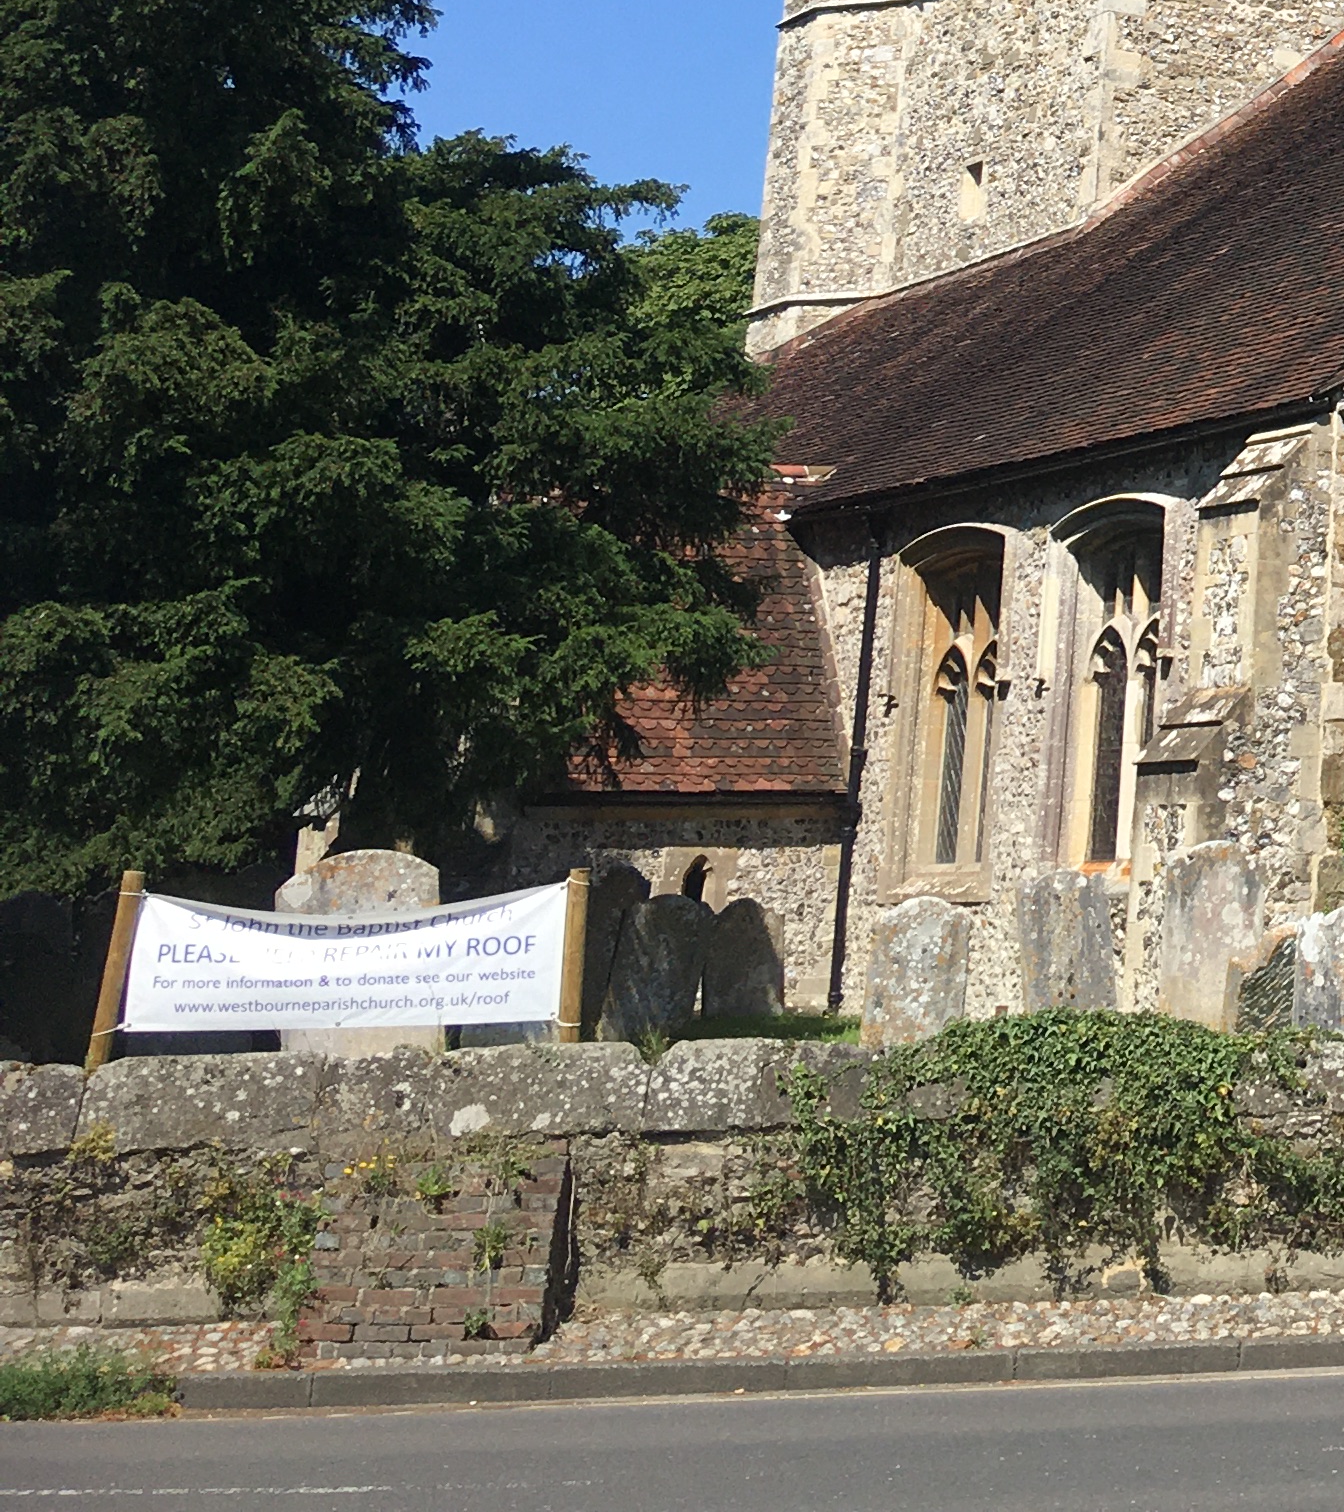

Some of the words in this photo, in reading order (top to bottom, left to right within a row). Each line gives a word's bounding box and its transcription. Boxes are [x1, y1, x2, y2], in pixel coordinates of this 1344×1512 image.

[222, 915, 279, 935] John
[288, 922, 328, 937] the
[337, 919, 422, 938] Baptist
[430, 906, 512, 927] Church
[418, 939, 457, 959] MY
[466, 935, 537, 957] ROOF
[153, 976, 178, 989] For
[182, 978, 221, 989] more
[227, 976, 313, 989] information
[318, 975, 330, 987] &
[336, 977, 352, 987] to
[357, 973, 410, 986] donate
[415, 974, 440, 984] see
[445, 973, 473, 983] our
[479, 968, 536, 981] website
[174, 991, 510, 1014] www.westbourneparishchurch.org.uk/roof
